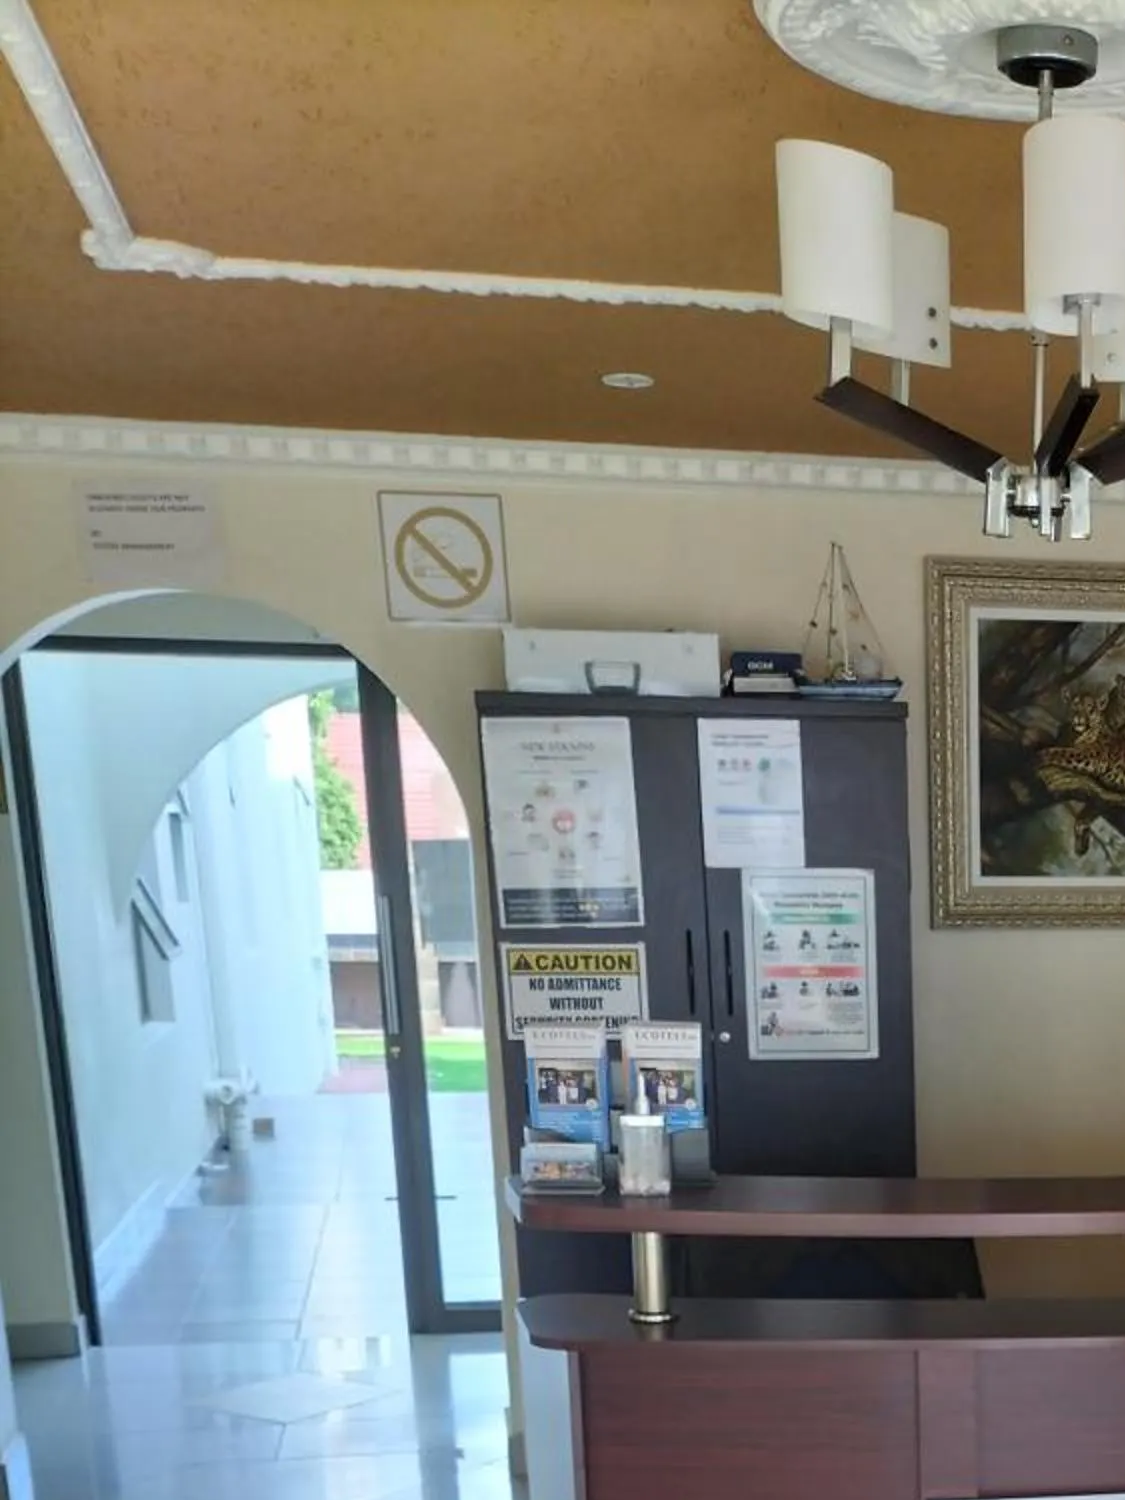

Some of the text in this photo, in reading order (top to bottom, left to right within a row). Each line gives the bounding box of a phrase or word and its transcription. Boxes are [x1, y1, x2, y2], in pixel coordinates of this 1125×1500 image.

[535, 954, 633, 971] CAUTION
[529, 977, 622, 991] NO ADMITTANCE
[549, 996, 604, 1010] WITHOUT
